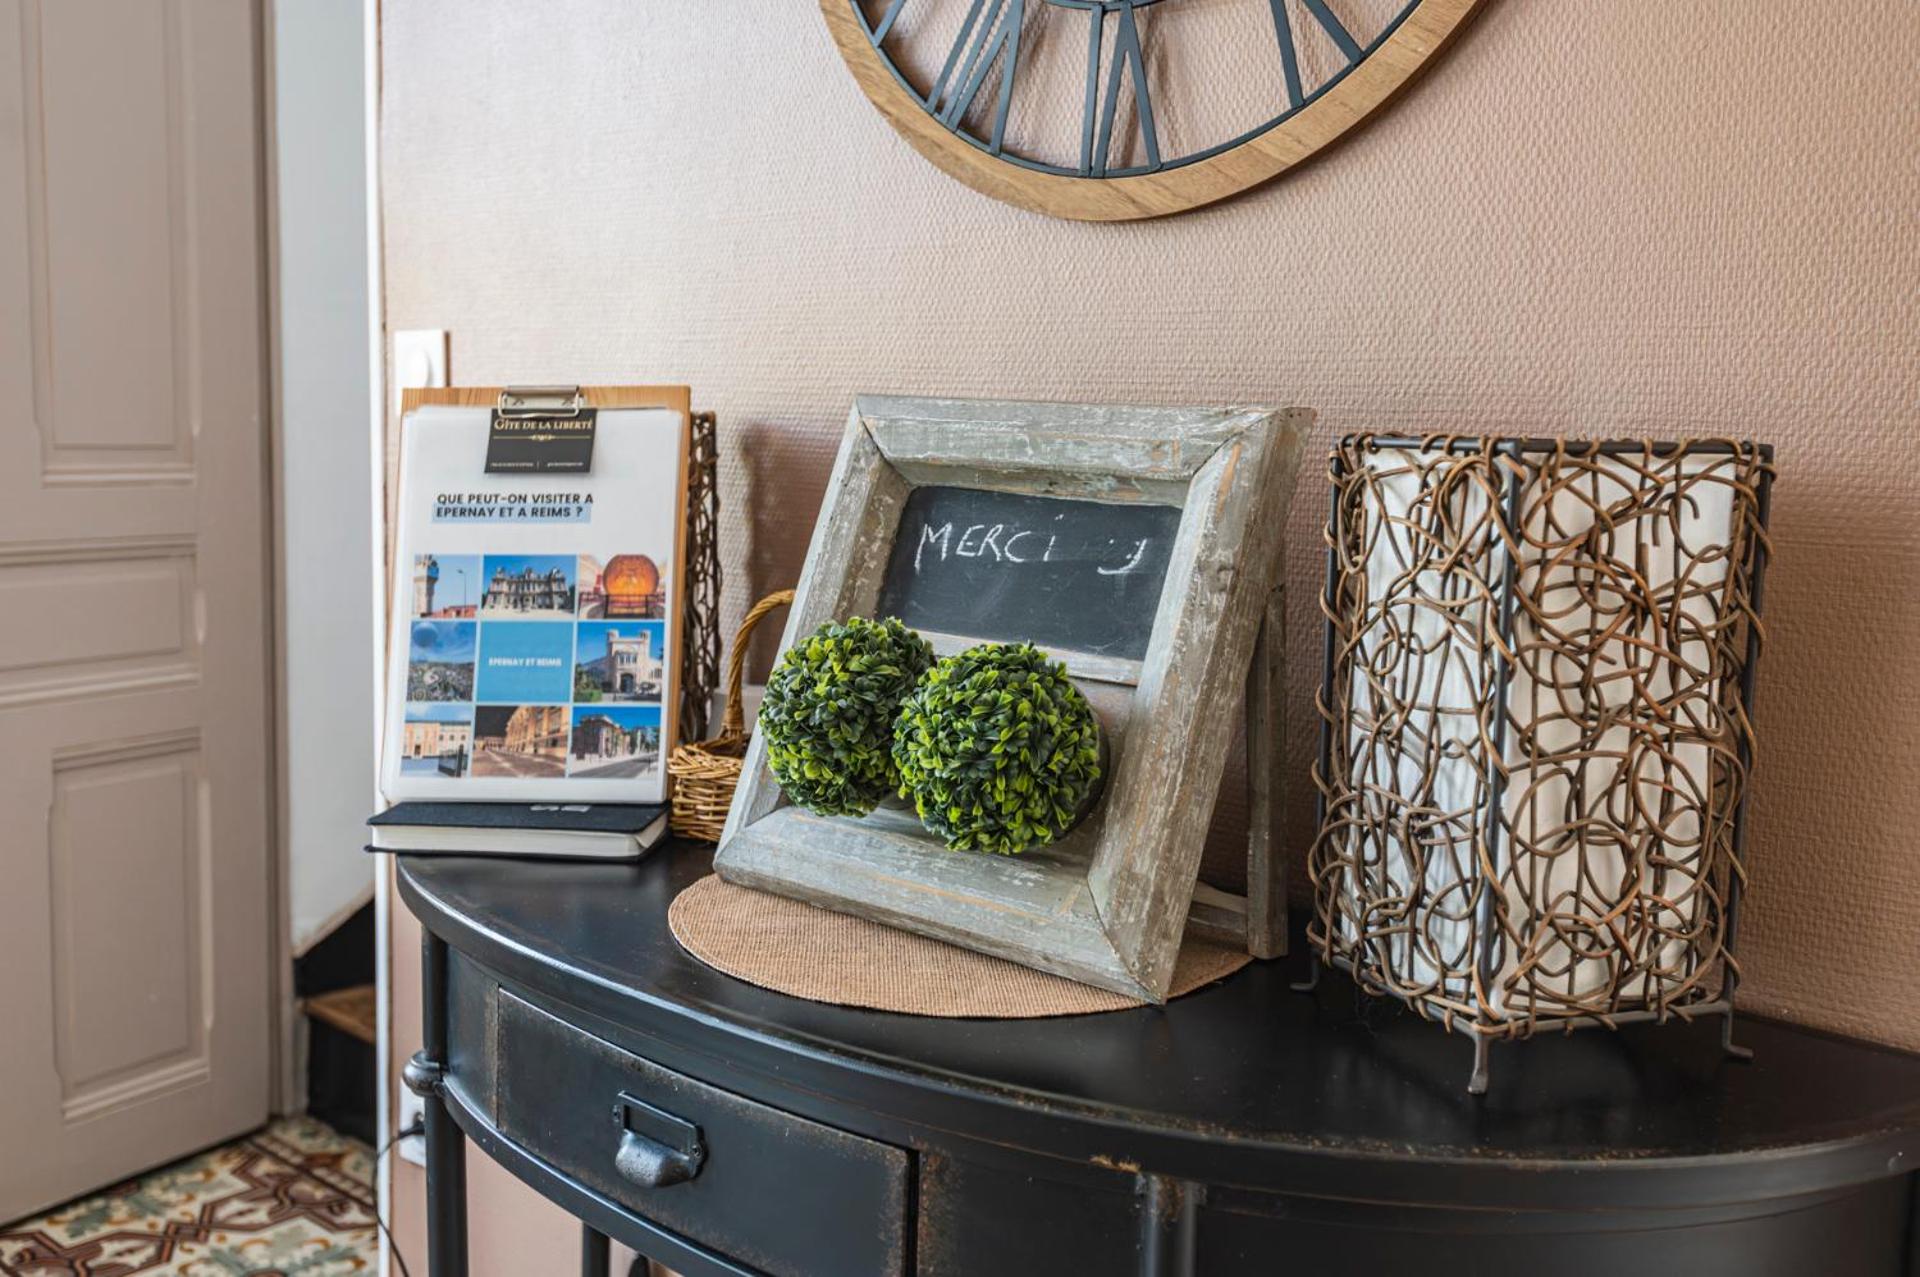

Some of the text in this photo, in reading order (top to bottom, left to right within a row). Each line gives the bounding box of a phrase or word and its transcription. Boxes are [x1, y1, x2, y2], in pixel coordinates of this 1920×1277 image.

[522, 420, 536, 430] DE
[538, 420, 551, 430] LA
[553, 418, 593, 430] LIBERTÉ
[437, 493, 594, 505] QUE PEUT-ON VISITER A
[436, 506, 583, 518] EPERNAY ET A REIMS ?
[488, 657, 524, 667] EPERNAY
